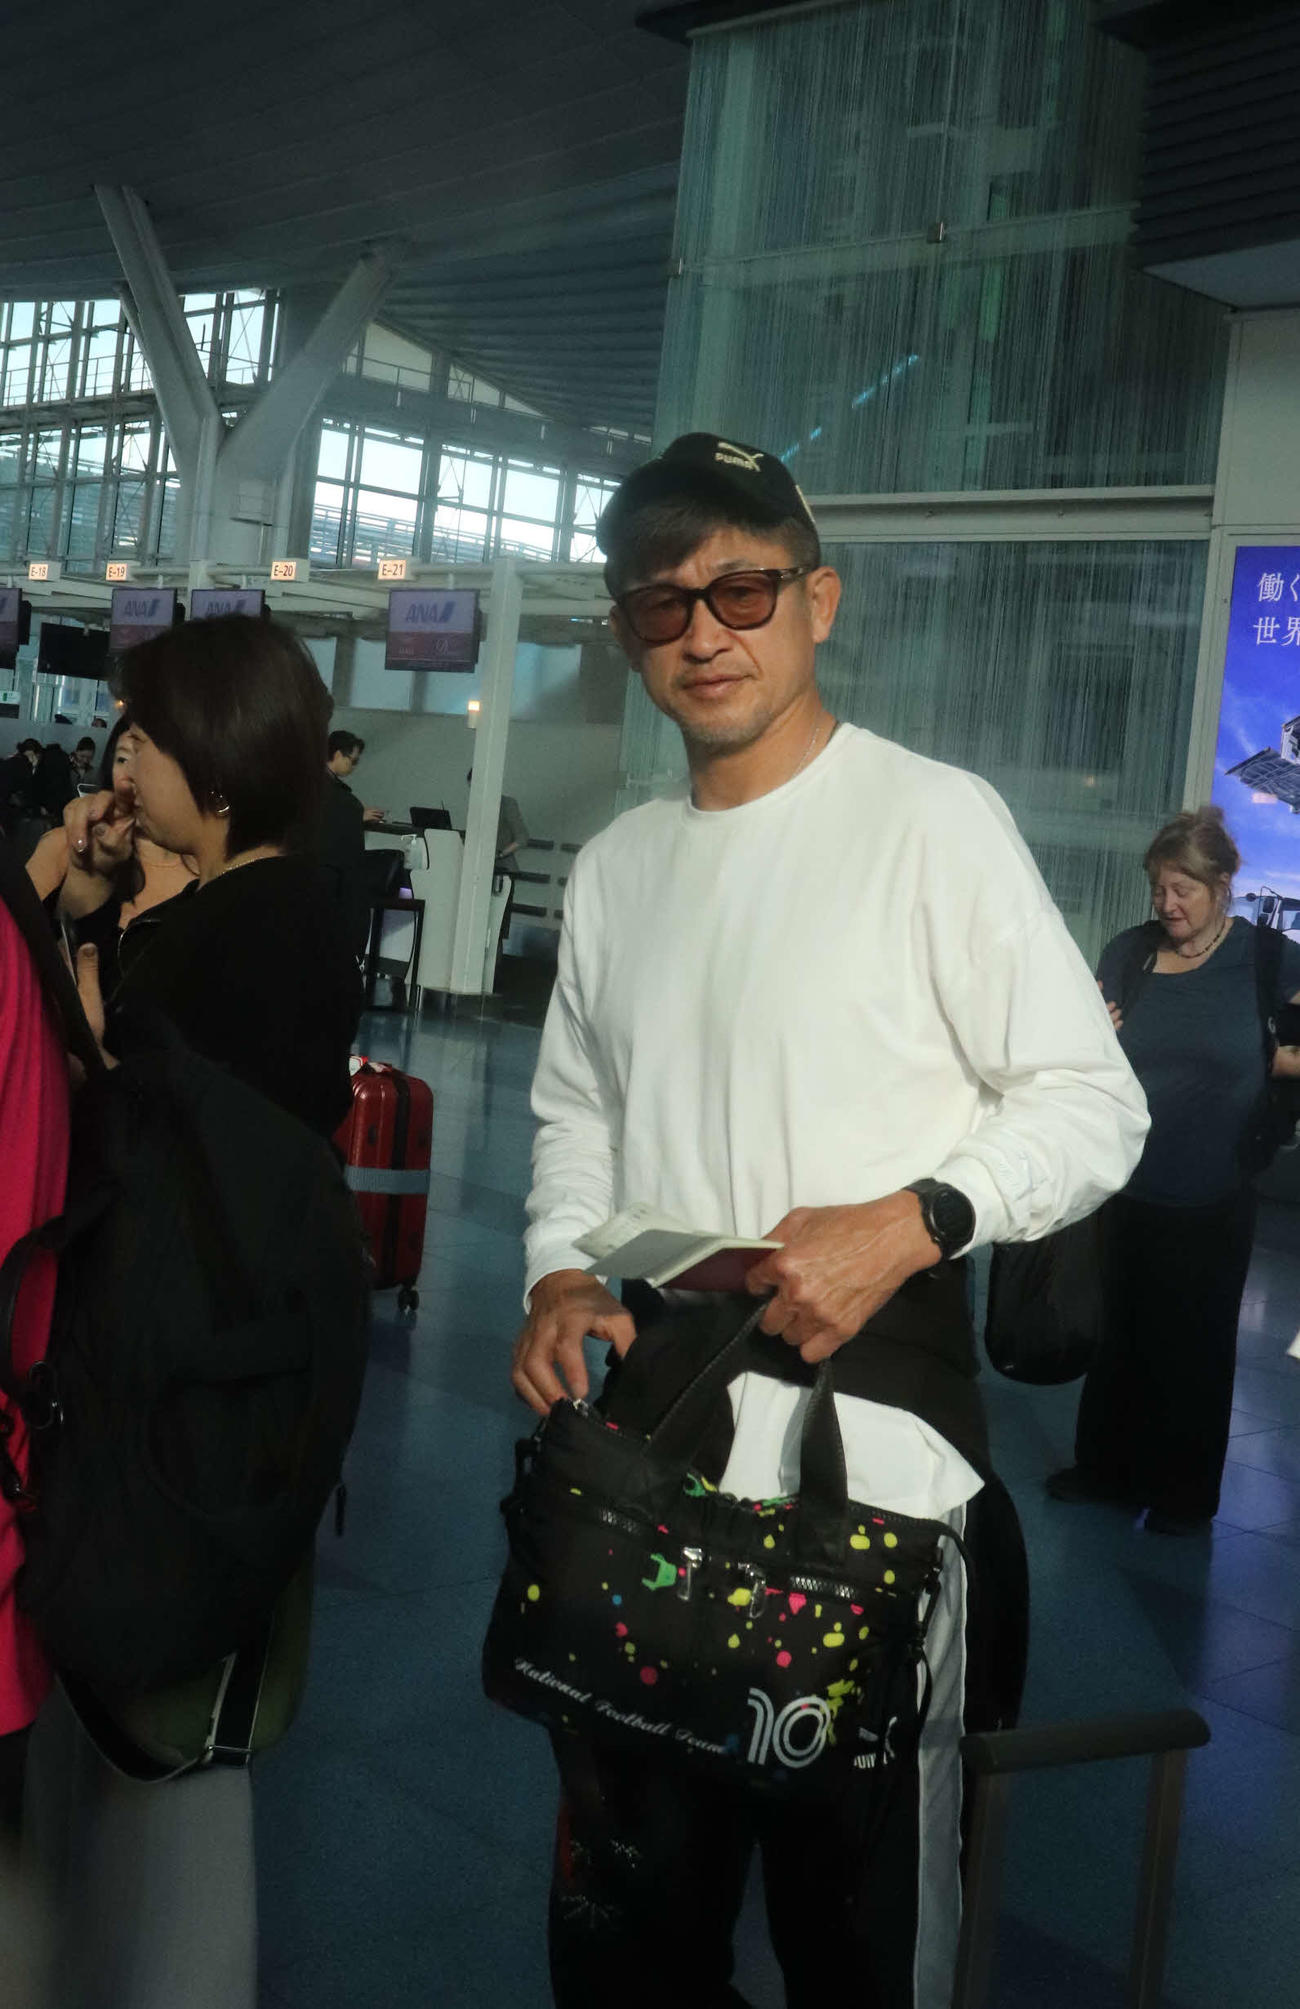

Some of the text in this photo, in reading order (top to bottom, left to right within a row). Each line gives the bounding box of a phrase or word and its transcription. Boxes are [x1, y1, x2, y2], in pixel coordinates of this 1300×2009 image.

[31, 566, 46, 577] E-18
[108, 566, 125, 578] E-19
[273, 565, 293, 577] E-20
[382, 563, 403, 577] E-21
[1257, 572, 1300, 602] 働く
[406, 603, 438, 622] ANA
[515, 1658, 592, 1703] National
[595, 1700, 672, 1735] Football
[748, 1687, 831, 1768] 10
